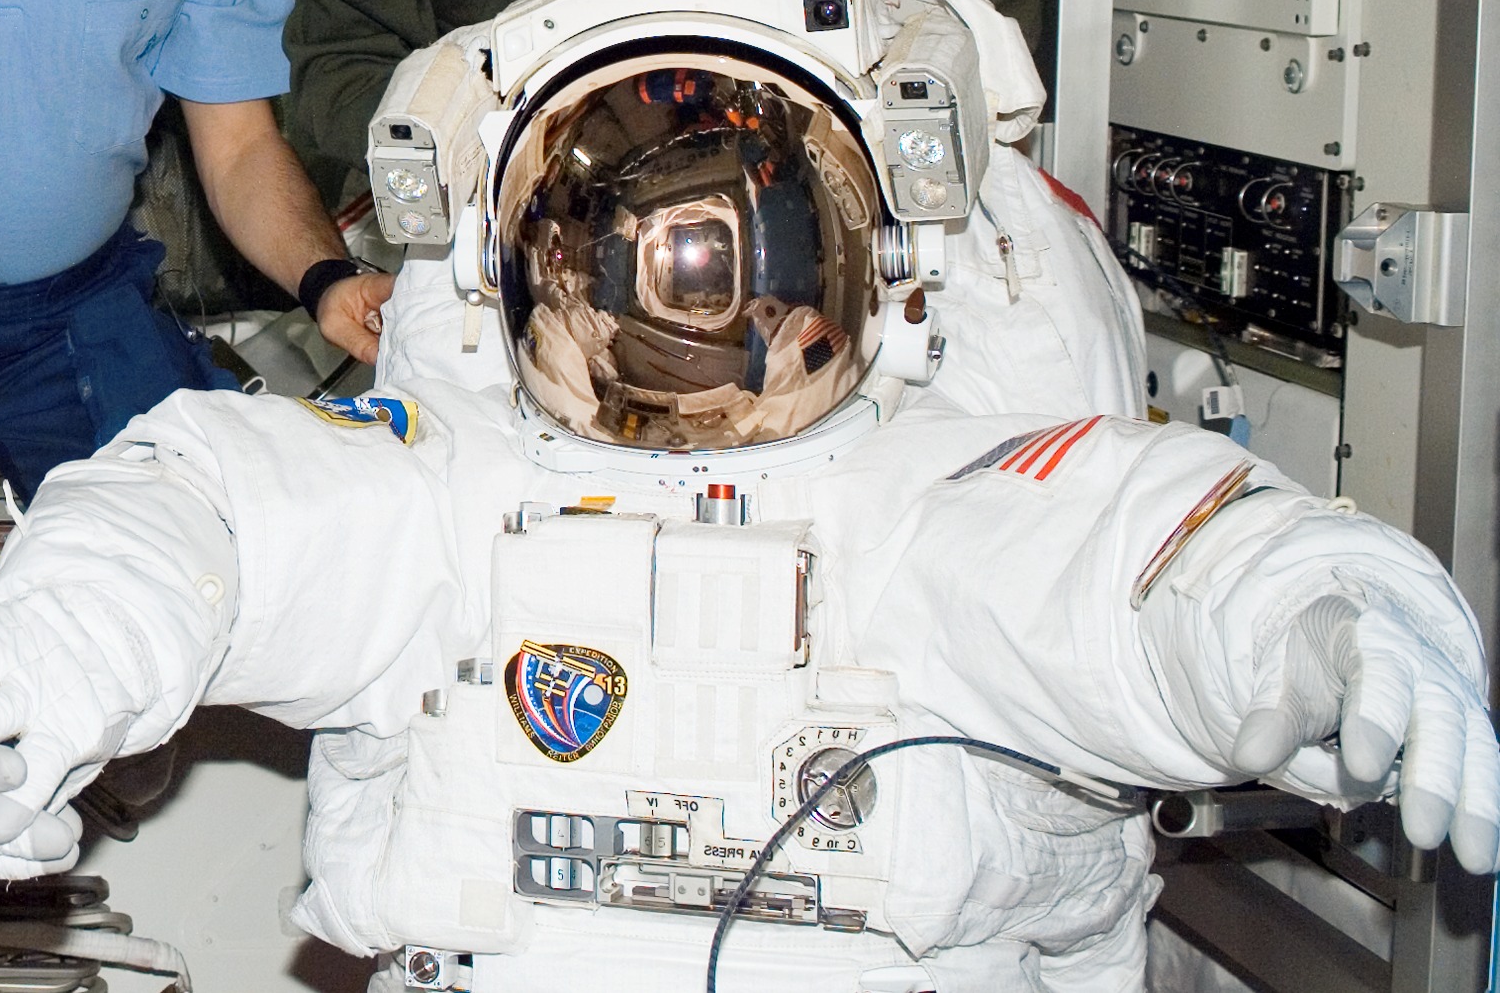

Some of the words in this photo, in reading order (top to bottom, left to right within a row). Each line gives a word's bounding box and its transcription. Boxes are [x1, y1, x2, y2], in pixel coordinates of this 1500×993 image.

[569, 647, 619, 674] EXPEDITION
[604, 676, 626, 696] 13
[509, 693, 536, 739] WILLIAMS
[546, 749, 580, 762] REITER
